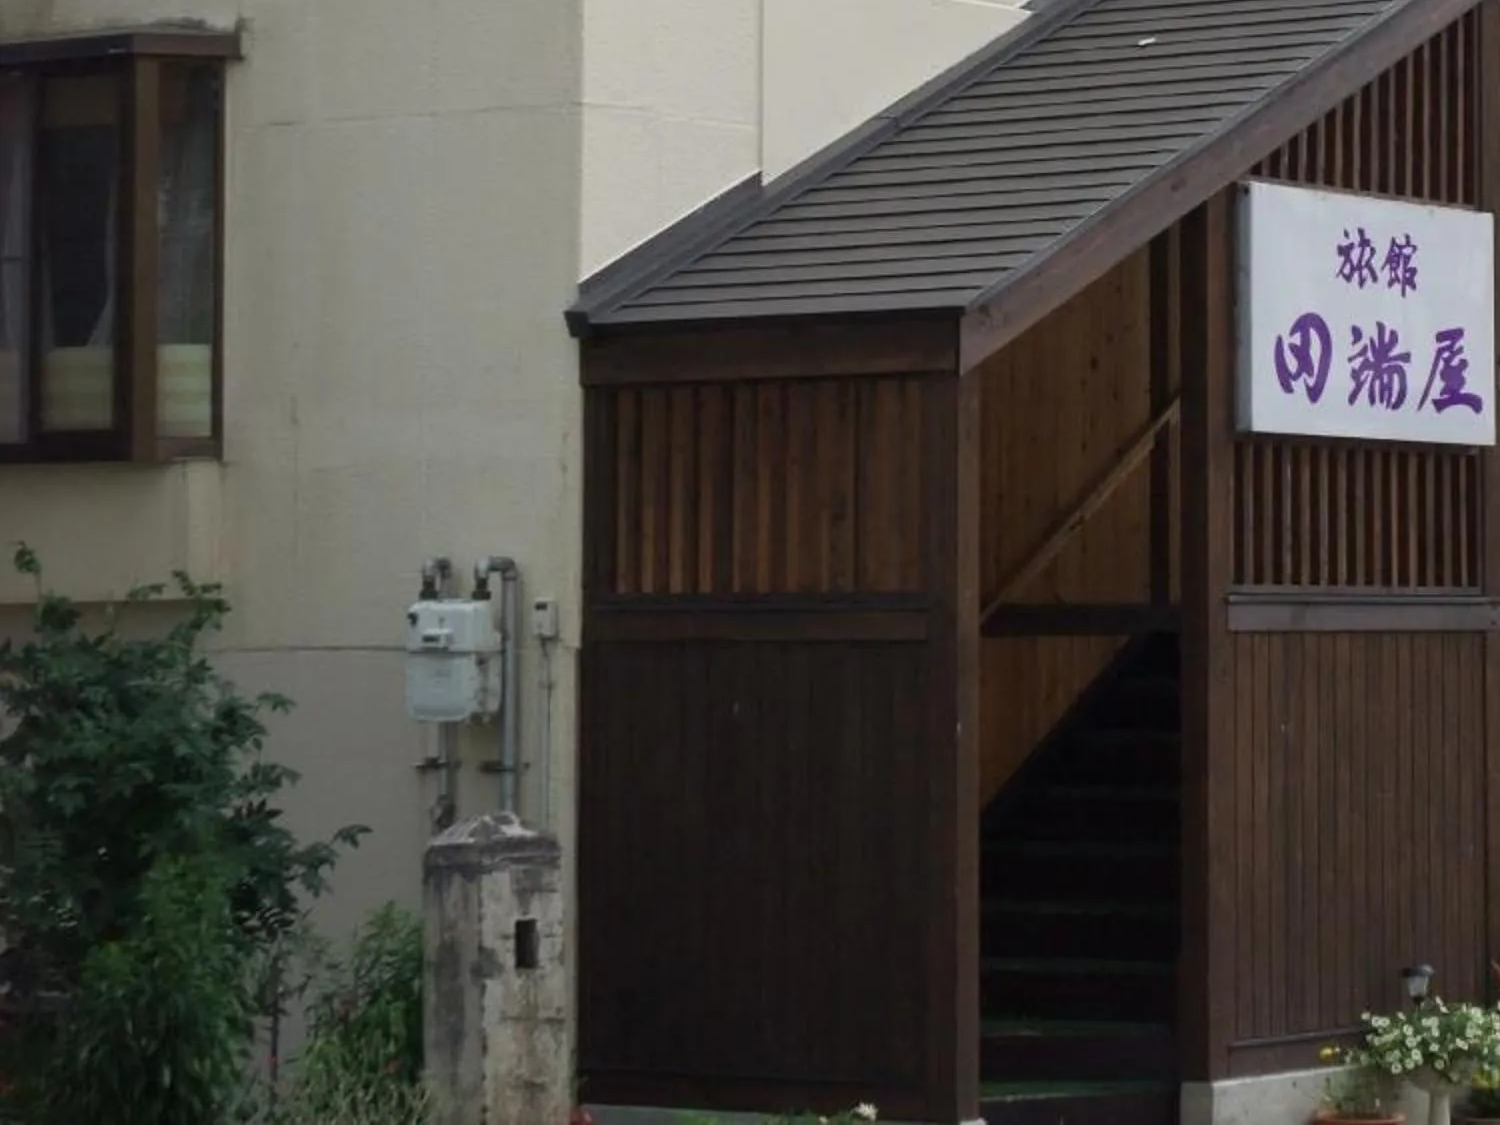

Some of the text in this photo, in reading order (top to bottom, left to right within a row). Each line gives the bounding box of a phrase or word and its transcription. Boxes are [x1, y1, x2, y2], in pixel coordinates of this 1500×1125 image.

[1335, 227, 1420, 297] 旅館
[1274, 312, 1483, 415] 田端屋
